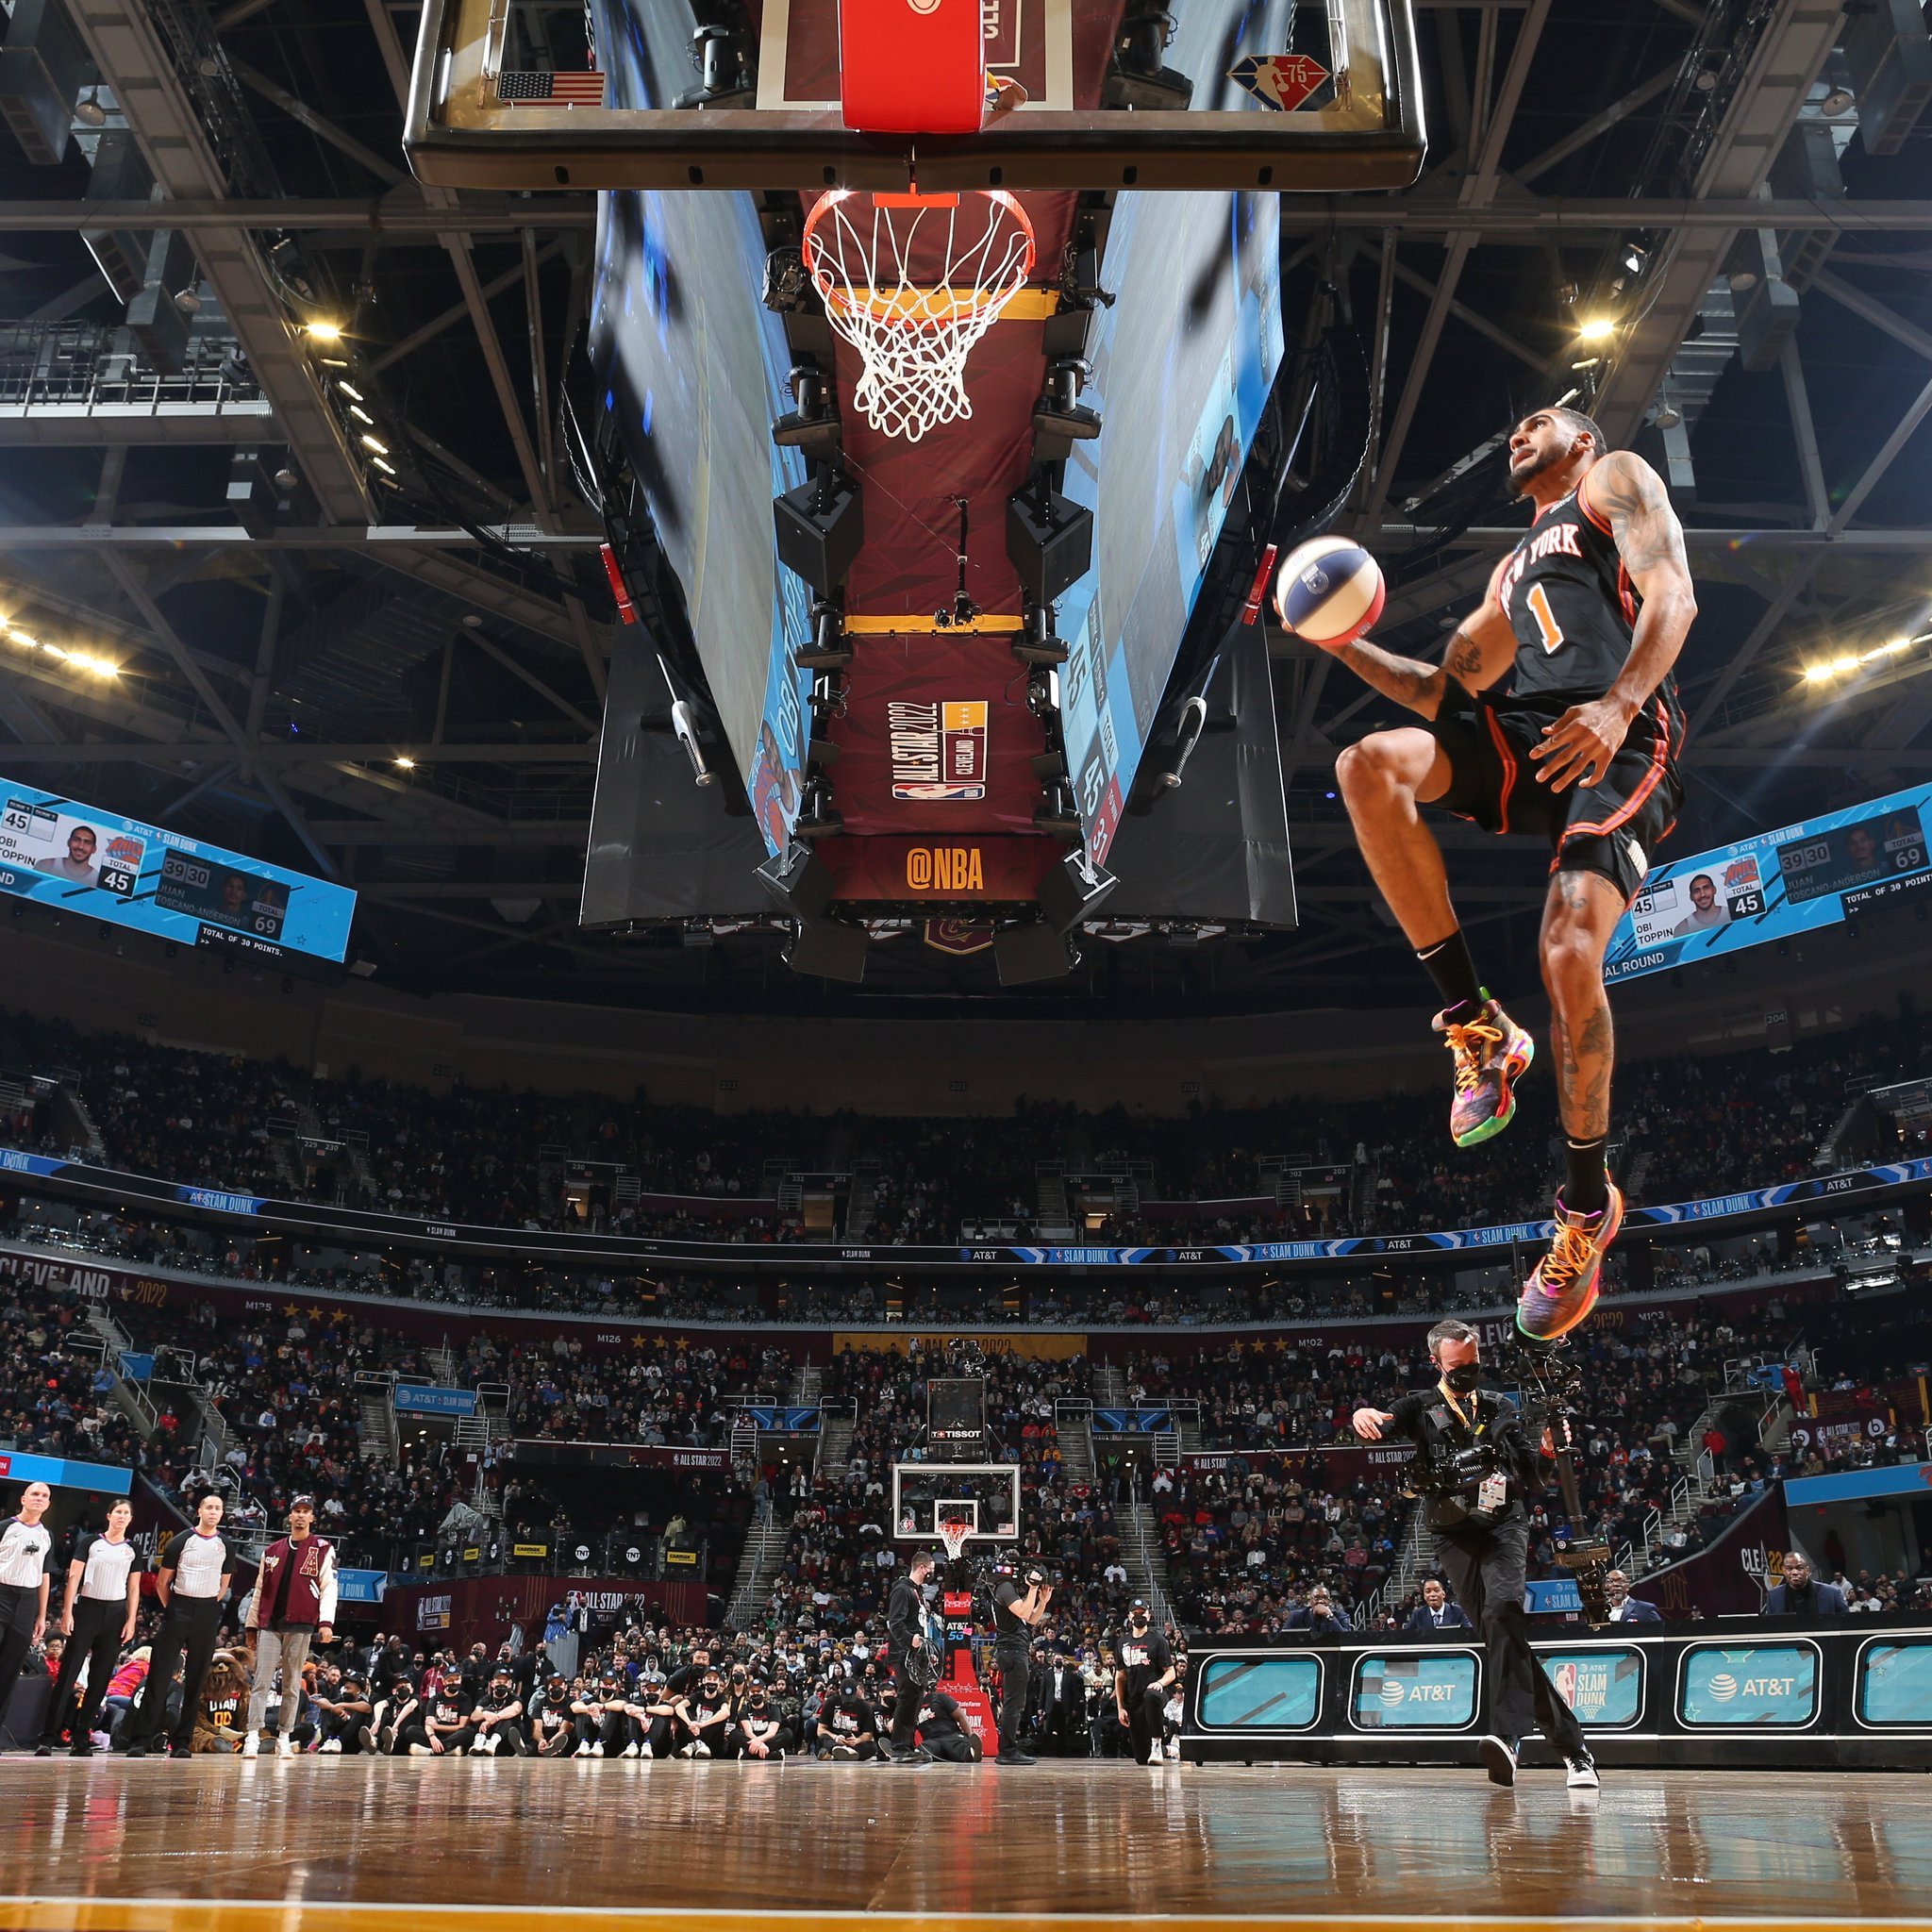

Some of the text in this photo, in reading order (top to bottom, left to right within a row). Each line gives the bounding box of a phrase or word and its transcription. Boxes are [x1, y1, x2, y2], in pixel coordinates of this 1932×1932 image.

[1287, 64, 1307, 83] 75
[1529, 523, 1583, 566] YORK
[1525, 581, 1565, 655] 1
[1067, 644, 1086, 710] 45
[1102, 715, 1116, 765] TOTAL
[955, 740, 974, 775] CLEVELAND
[1083, 755, 1105, 817] 45
[6, 813, 28, 829] 45
[133, 825, 154, 838] AT&T
[1739, 841, 1758, 854] AT&T
[1890, 836, 1918, 849] TOTAL
[109, 858, 132, 871] TOTAL
[1782, 845, 1828, 871] 39 30
[1895, 848, 1921, 868] 69
[165, 860, 208, 884] 39 30
[907, 848, 984, 891] @NBA
[105, 872, 129, 891] 45
[1731, 884, 1755, 895] TOTAL
[1787, 875, 1814, 891] JUAN
[158, 884, 186, 898] JUAN
[1845, 891, 1872, 904] TOTAL
[1875, 888, 1886, 896] OF
[1890, 883, 1901, 891] 30
[258, 904, 279, 915] TOTAL
[1634, 898, 1652, 914] 45
[1735, 894, 1758, 914] 45
[255, 916, 276, 934] 69
[1636, 923, 1652, 934] OBI
[202, 926, 225, 940] TOTAL
[241, 938, 251, 946] 30
[254, 941, 283, 957] POINTS.
[1638, 928, 1674, 944] TOPPIN
[1622, 952, 1665, 972] ROUND
[3, 1152, 30, 1171] DUNK
[1826, 1178, 1853, 1191] AT&T
[228, 1197, 254, 1213] DUNK
[1701, 1194, 1750, 1217] SLAM DUNK
[1481, 1229, 1503, 1243] SLAM
[1270, 1243, 1315, 1257] SLAM DUNK
[1388, 1240, 1412, 1250] AT&T
[973, 1251, 997, 1259] AT&T
[1064, 1250, 1108, 1263] SLAM DUNK
[1178, 1252, 1203, 1260] AT&T
[136, 1279, 167, 1307] 2022
[597, 1334, 621, 1343] M126
[412, 1393, 437, 1404] AT&T
[945, 1430, 981, 1439] TISSOT
[708, 1455, 722, 1467] 2022
[299, 1546, 319, 1576] A
[345, 1584, 366, 1597] DUNK
[1552, 1594, 1571, 1608] SLAM
[946, 1622, 969, 1631] AT&T
[947, 1630, 965, 1641] 5G
[1578, 1674, 1607, 1691] SLAM
[1741, 1677, 1795, 1697] AT&T
[1407, 1684, 1456, 1701] AT&T
[1576, 1690, 1607, 1707] DUNK
[208, 1697, 237, 1712] UTAH
